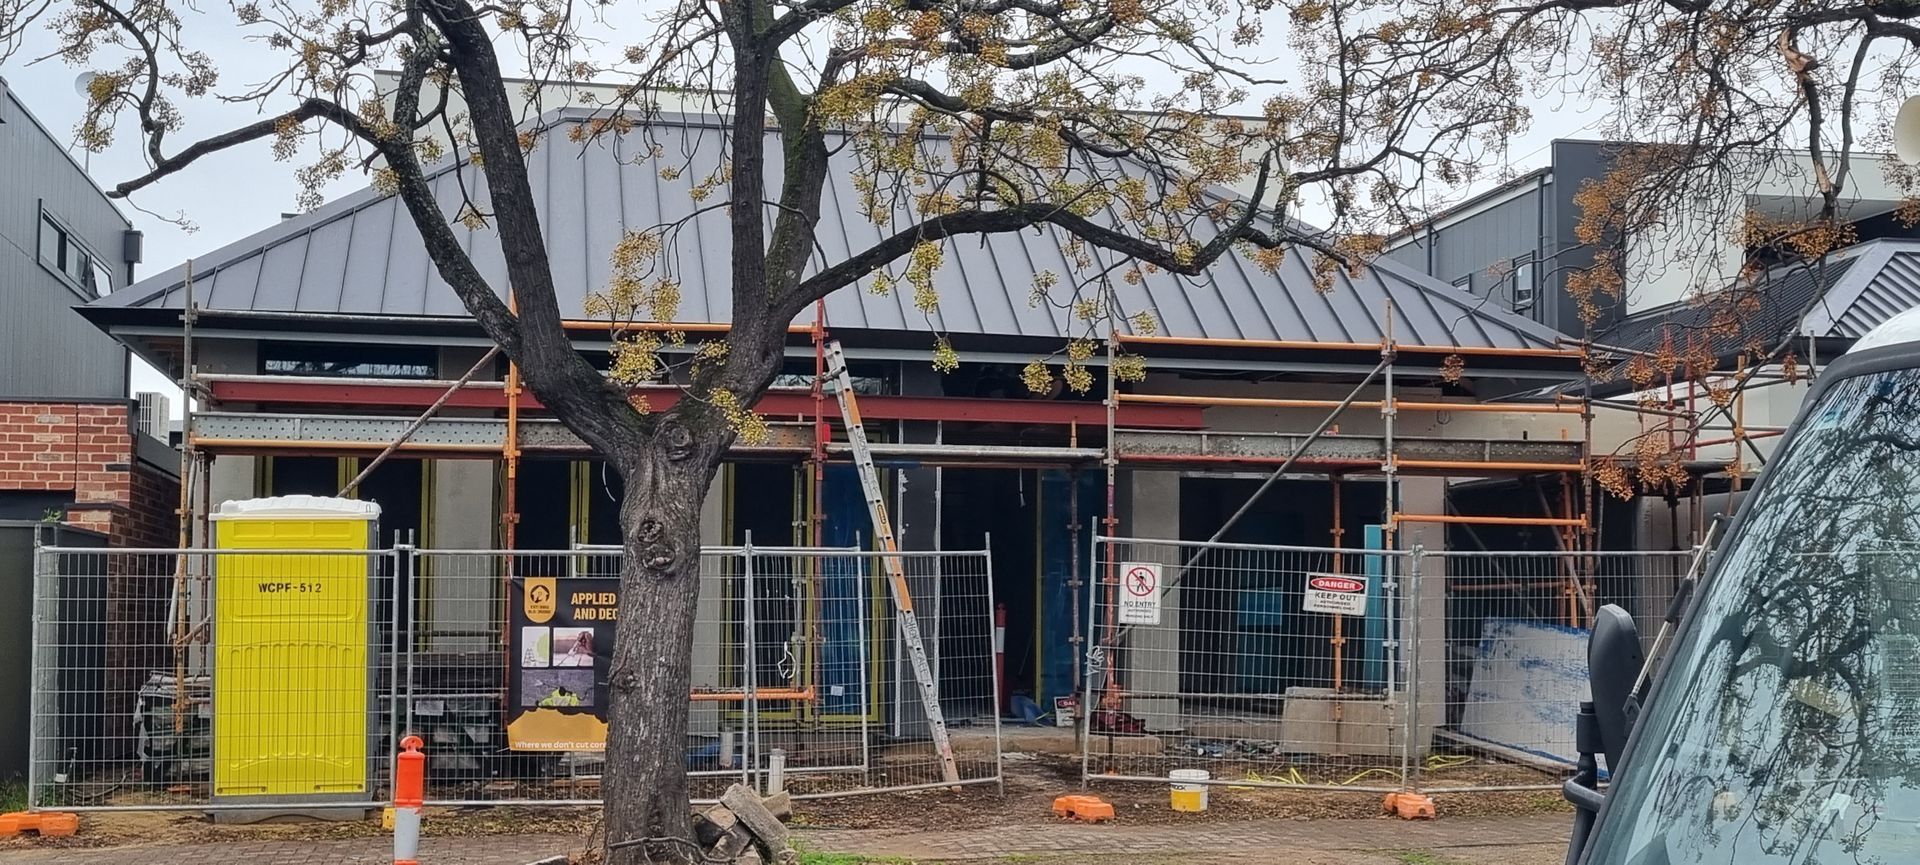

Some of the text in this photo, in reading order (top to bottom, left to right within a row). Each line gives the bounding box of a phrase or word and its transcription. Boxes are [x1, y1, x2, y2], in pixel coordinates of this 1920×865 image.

[258, 582, 322, 593] WCPF-512
[1318, 580, 1356, 590] DANGER
[571, 592, 617, 605] APPLIED
[1315, 592, 1357, 602] KEEP OUT
[573, 608, 596, 621] AND
[514, 741, 540, 749] Where
[553, 741, 574, 749] don't
